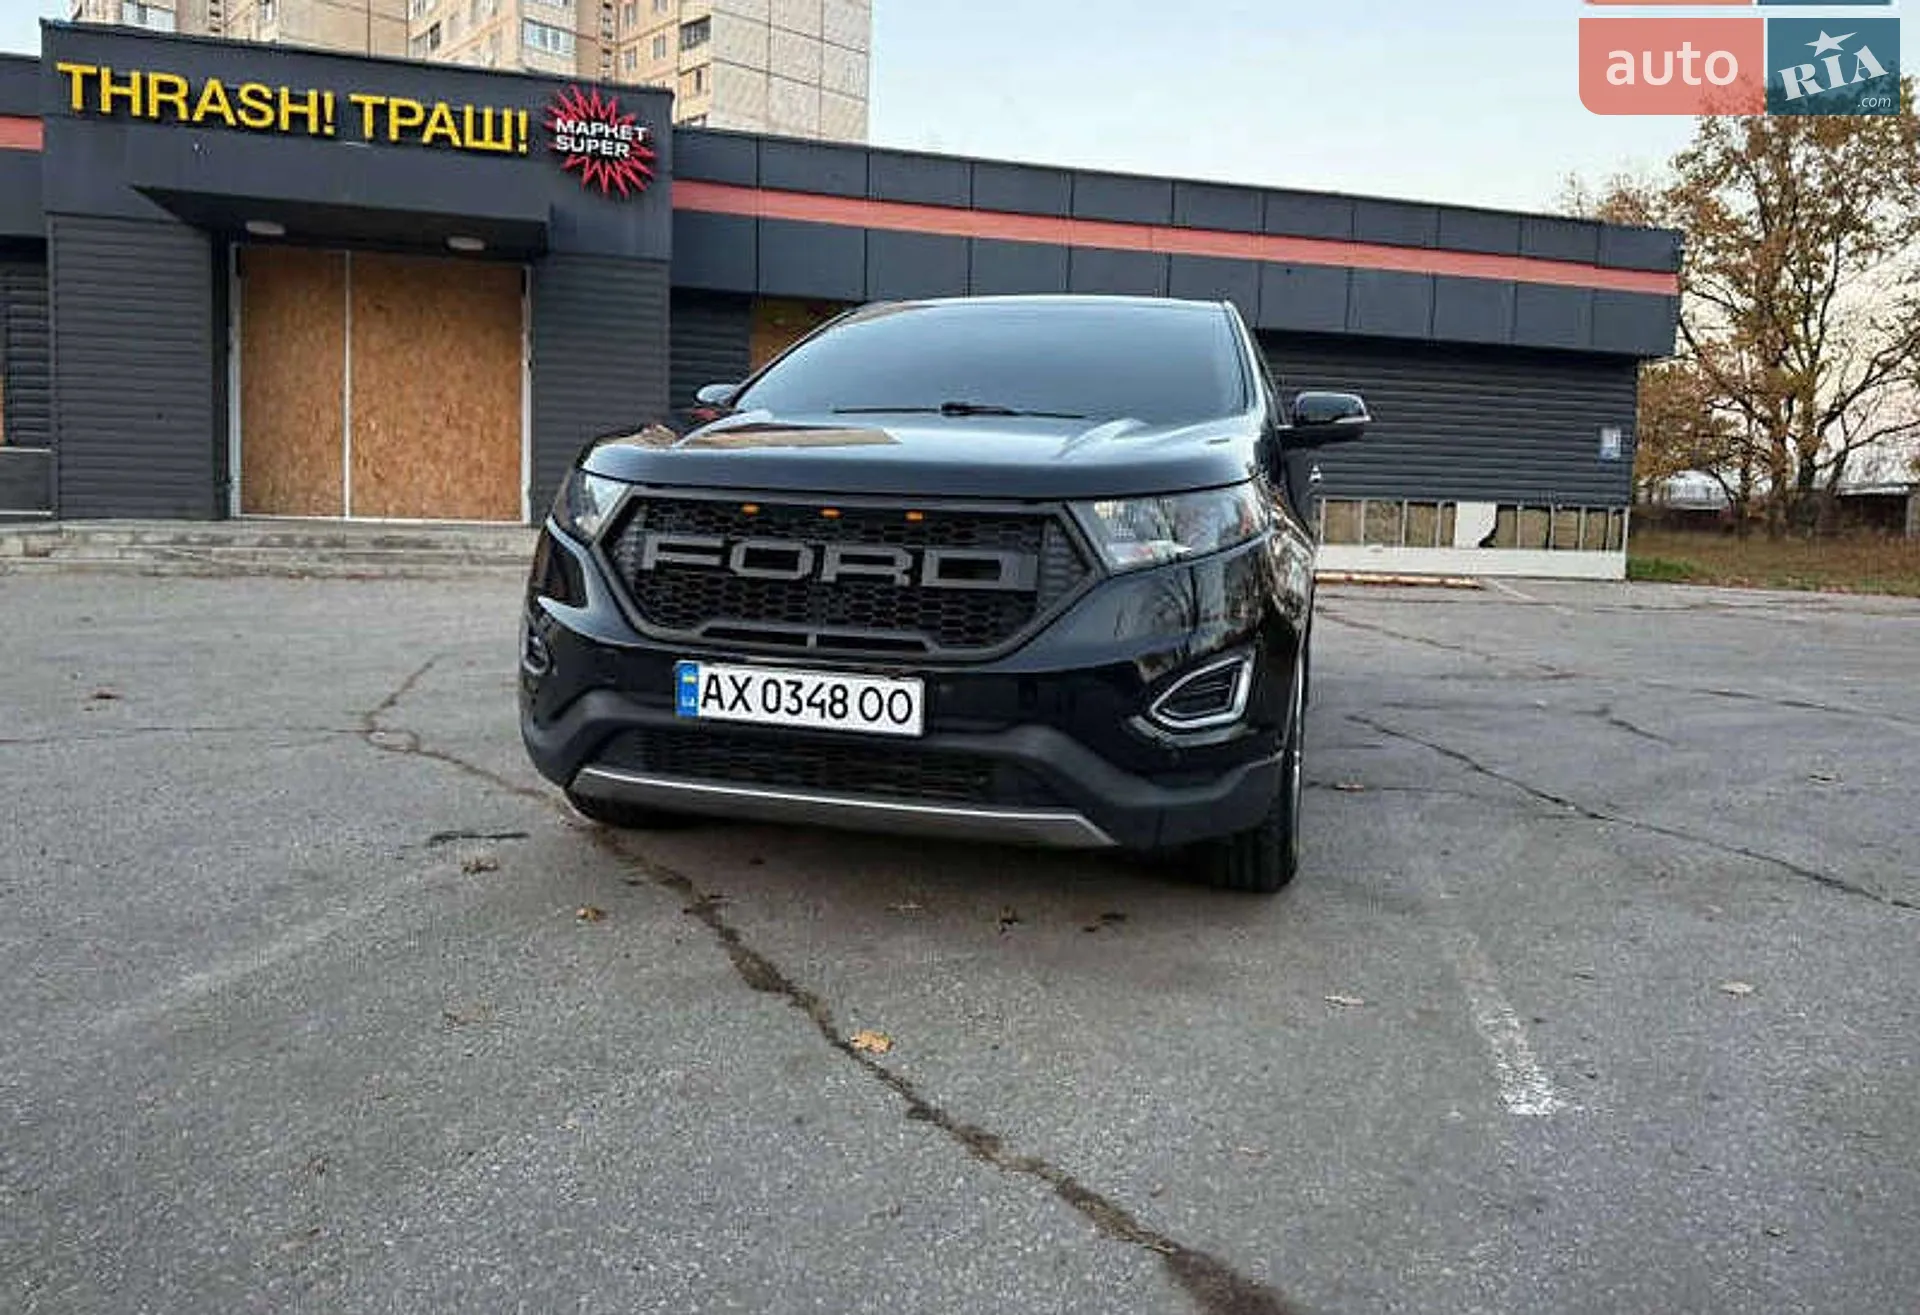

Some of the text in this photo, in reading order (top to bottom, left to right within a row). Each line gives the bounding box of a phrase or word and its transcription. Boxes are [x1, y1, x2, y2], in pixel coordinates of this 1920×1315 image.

[56, 61, 335, 136] THRASH!
[349, 93, 528, 154] ТРАШ!
[556, 134, 631, 158] SUPER
[641, 532, 1039, 591] FORD
[701, 674, 752, 712] AX
[761, 679, 849, 719] 0348
